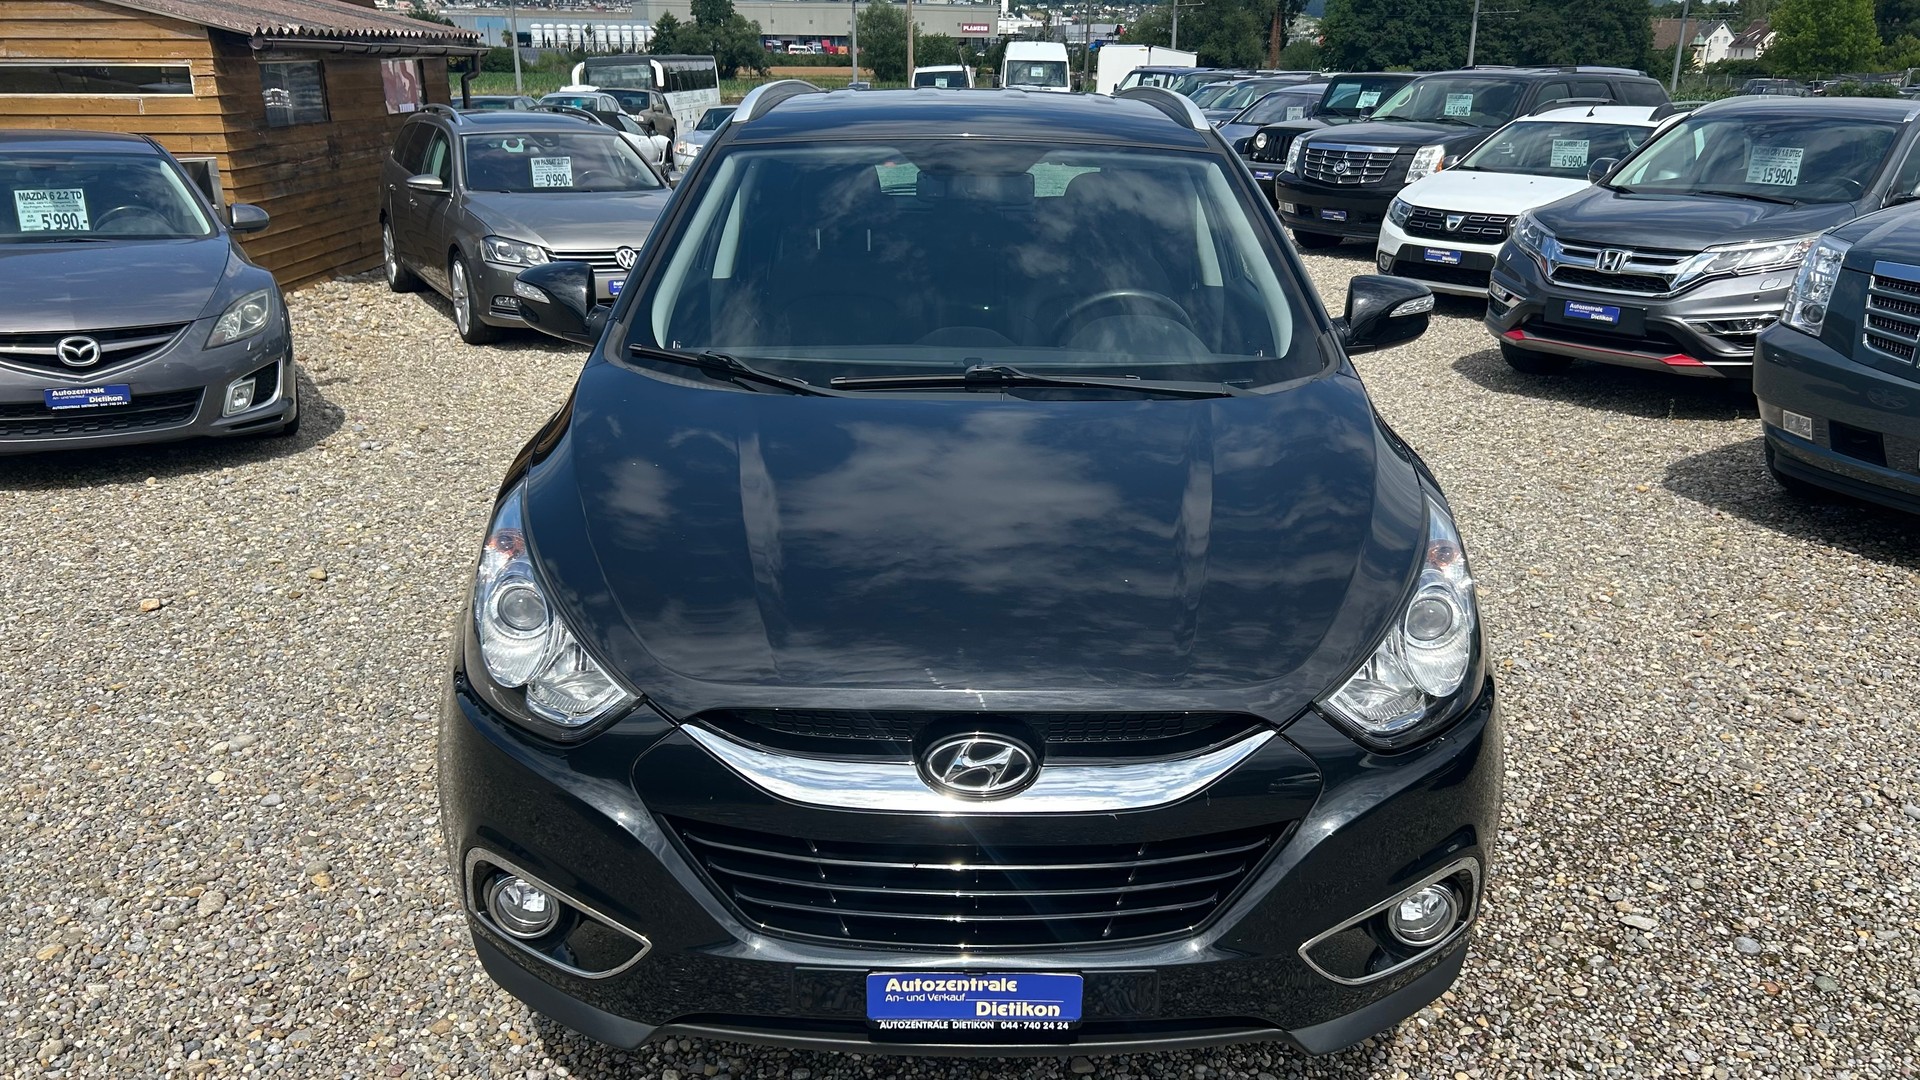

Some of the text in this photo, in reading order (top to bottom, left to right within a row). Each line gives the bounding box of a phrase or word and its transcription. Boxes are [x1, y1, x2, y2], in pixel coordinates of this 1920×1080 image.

[545, 173, 572, 187] 9'990.-
[1761, 167, 1797, 185] 15'990.-
[18, 190, 82, 201] MAZDA 6 2.2 TD
[41, 212, 88, 231] 5'990.-
[52, 387, 104, 396] Autozentrale
[88, 395, 123, 403] Dietikon
[885, 977, 1018, 993] Autozentrale
[885, 993, 966, 1002] An- und Verkauf
[976, 1001, 1061, 1017] Dietikon
[879, 1020, 949, 1030] AUTOZENTRALE
[952, 1020, 995, 1030] DIETIKON
[1042, 1020, 1055, 1030] 24
[1057, 1020, 1069, 1030] 24
